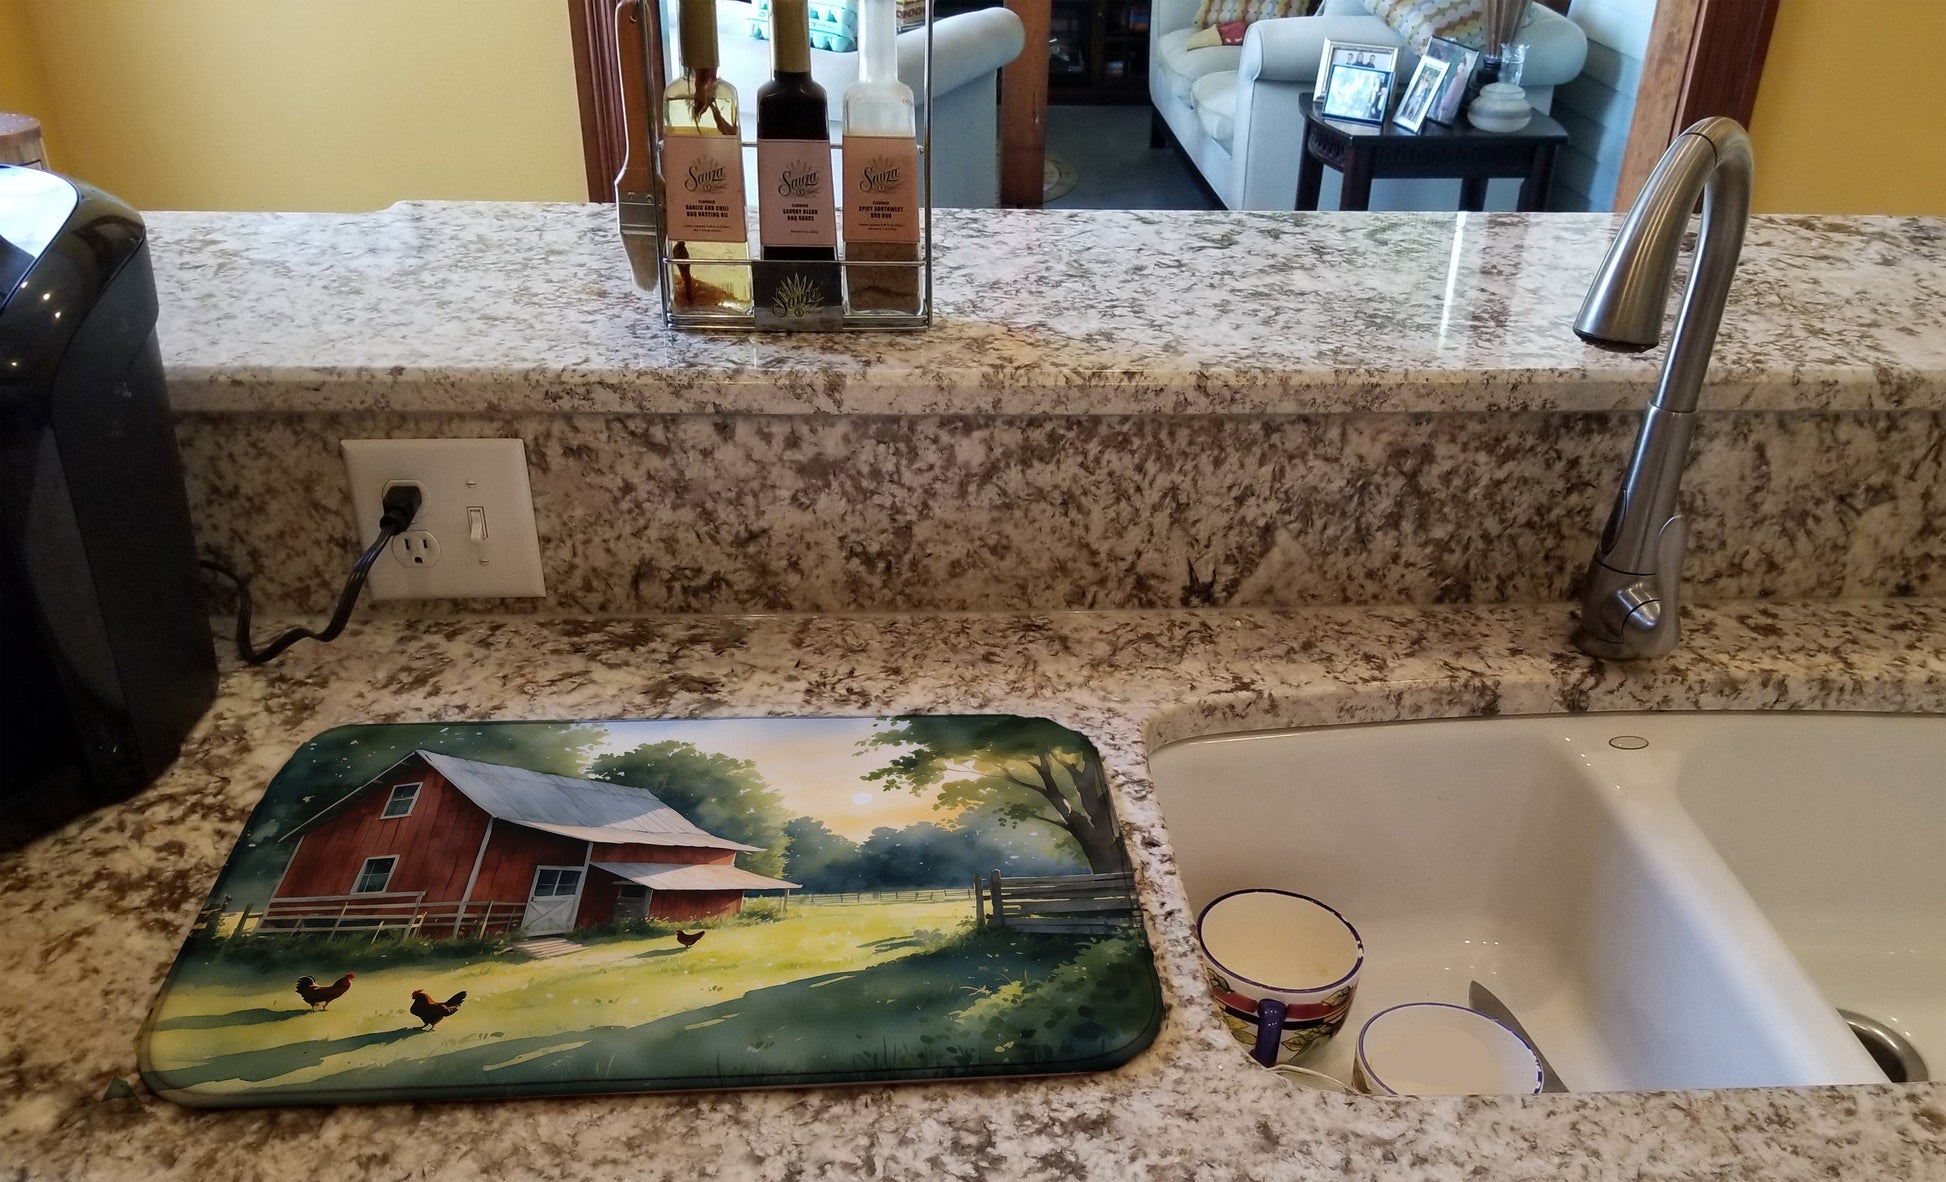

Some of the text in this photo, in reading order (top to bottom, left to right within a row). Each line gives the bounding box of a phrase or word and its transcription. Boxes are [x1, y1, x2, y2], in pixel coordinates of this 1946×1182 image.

[685, 166, 725, 191] Sauza
[778, 171, 818, 196] Sauza
[860, 167, 900, 192] Sauza
[772, 287, 821, 317] Sauza
